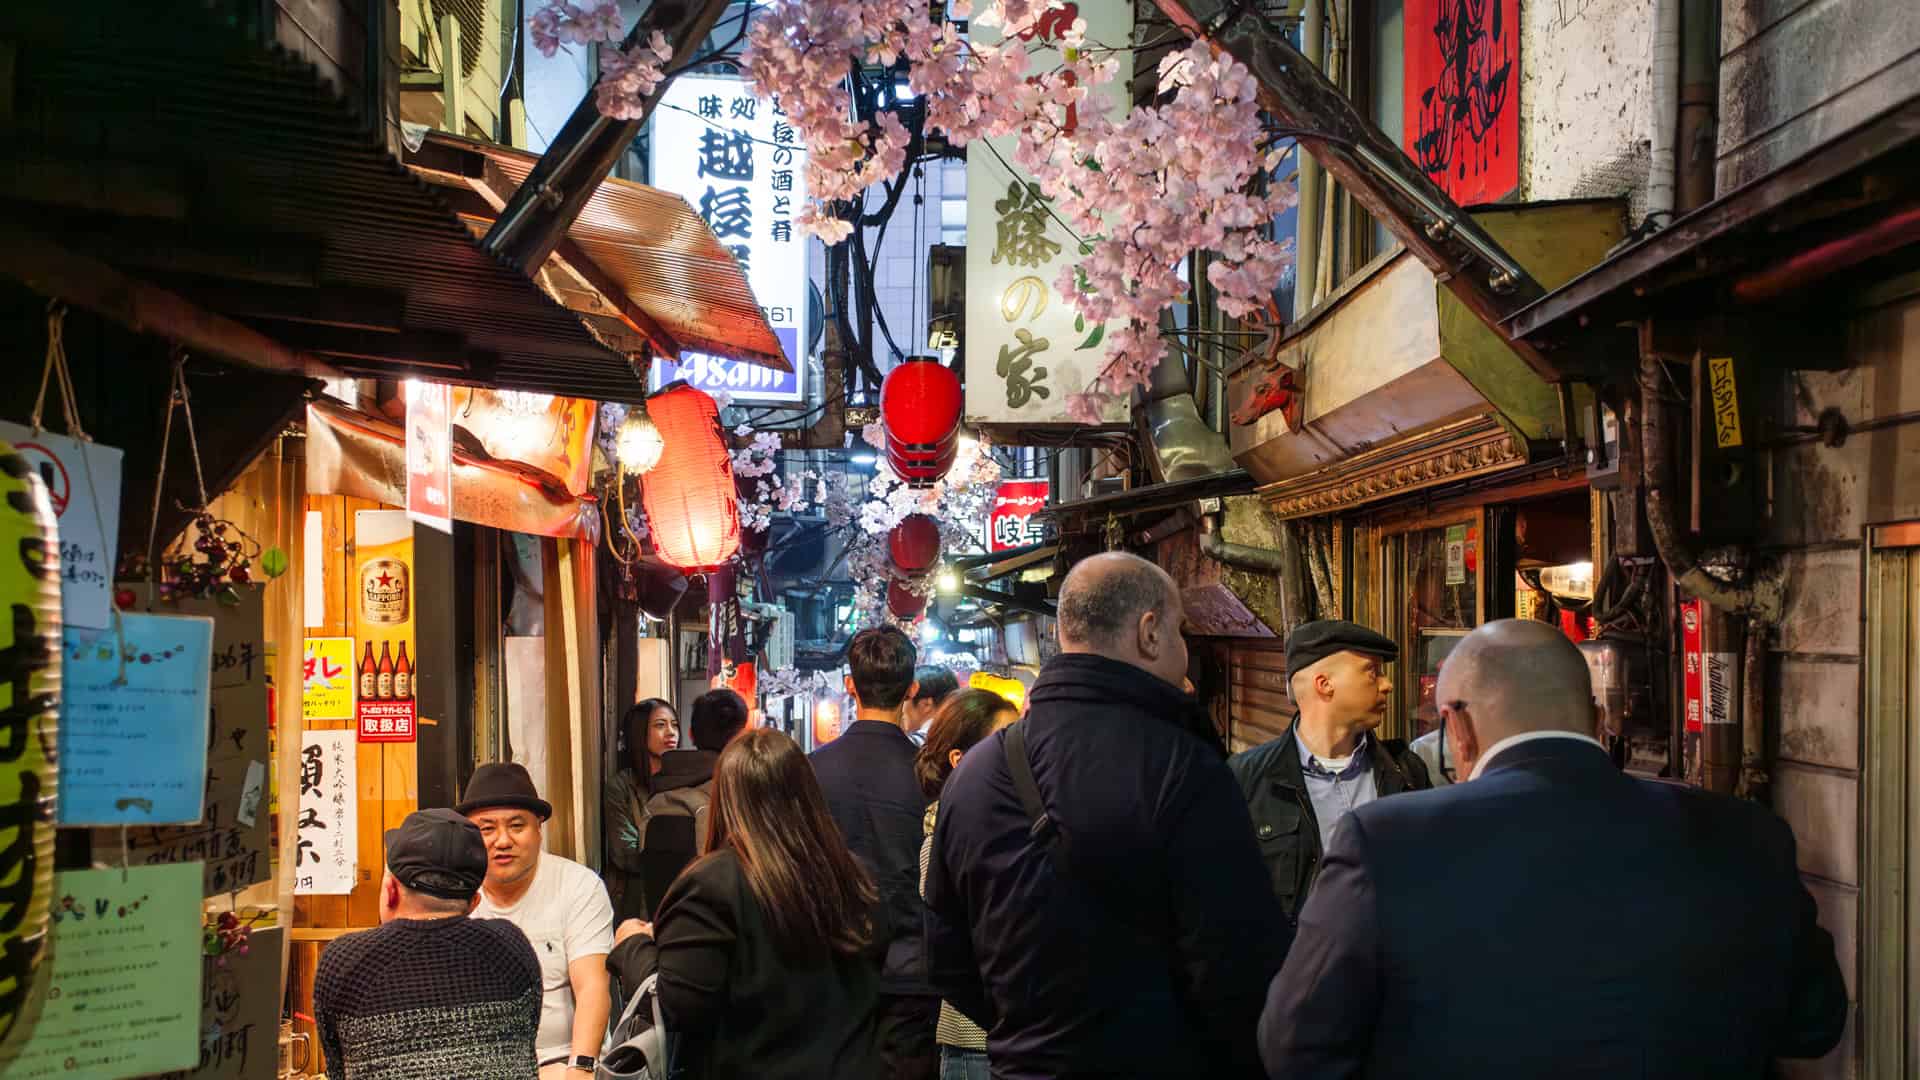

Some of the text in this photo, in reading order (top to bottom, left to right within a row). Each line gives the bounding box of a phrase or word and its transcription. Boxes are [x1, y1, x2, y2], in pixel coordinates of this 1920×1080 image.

[698, 93, 755, 120] 味処
[697, 127, 754, 277] 越後
[991, 179, 1062, 409] 藤の家
